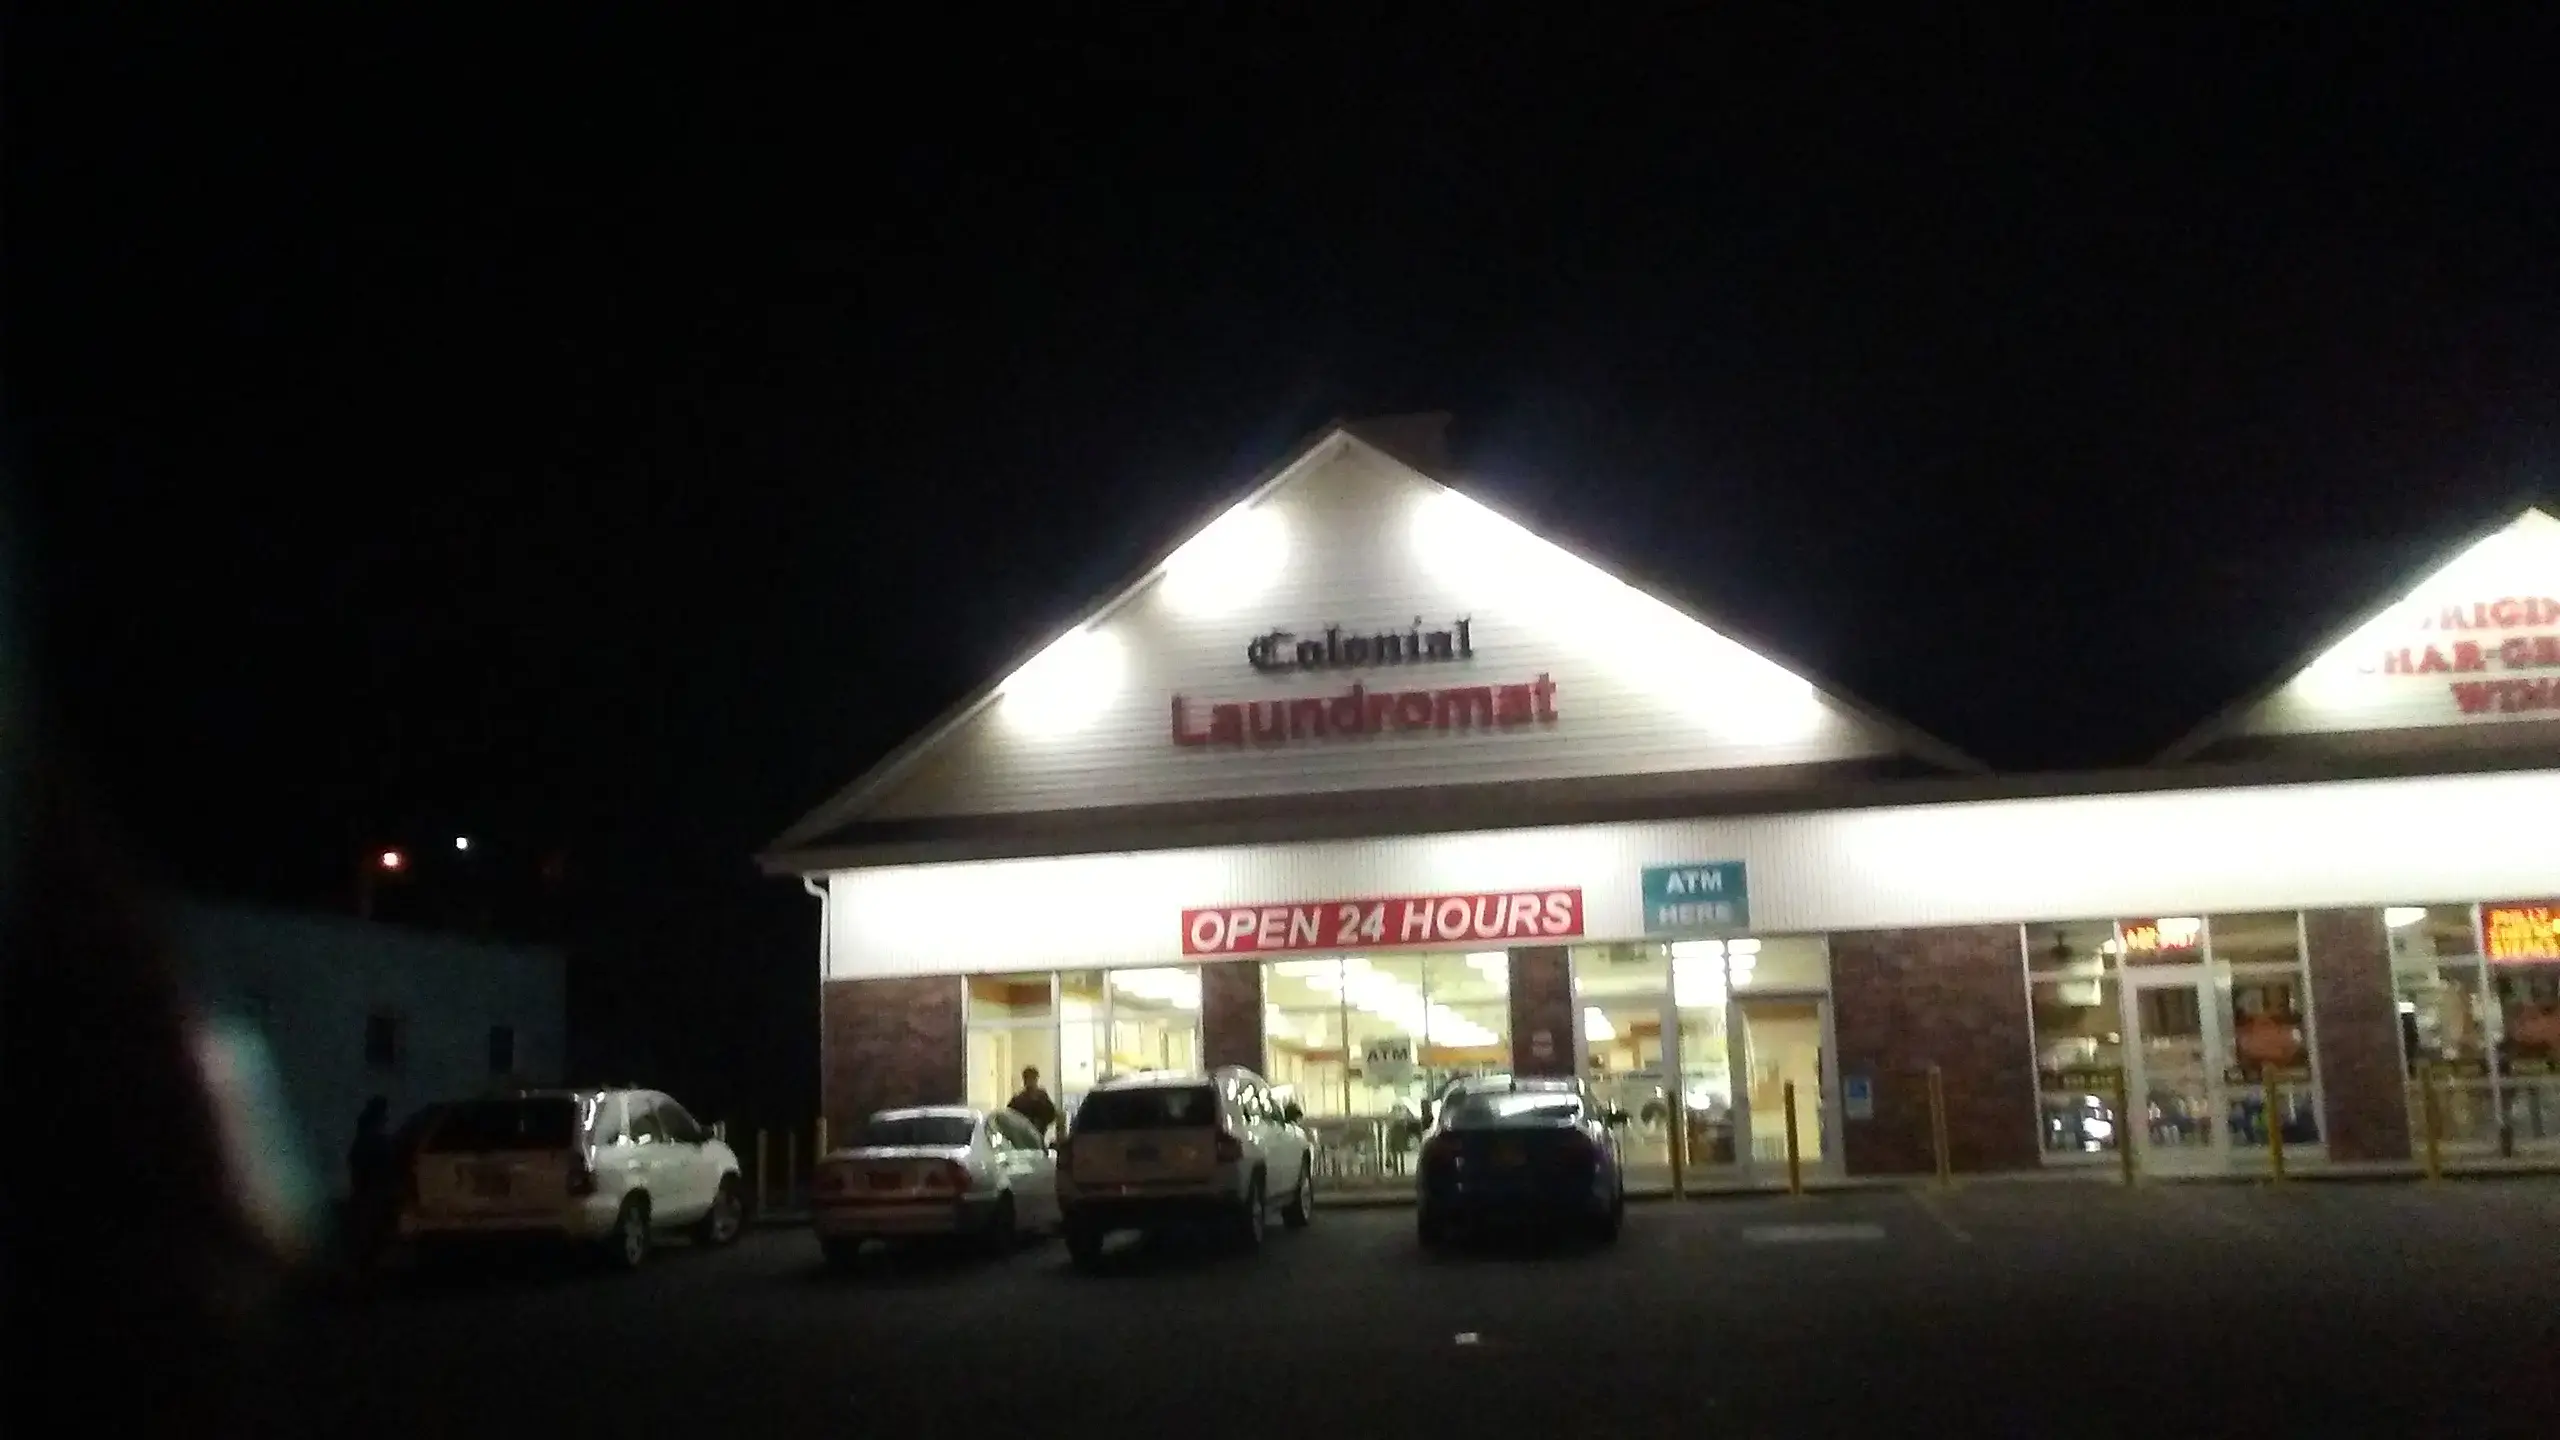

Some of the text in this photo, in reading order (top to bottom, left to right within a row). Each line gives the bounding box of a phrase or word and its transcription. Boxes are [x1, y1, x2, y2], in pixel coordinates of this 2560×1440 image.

[1247, 613, 1473, 673] Colonial
[1172, 673, 1558, 748] Laundromat
[1665, 868, 1722, 895] ATM
[1190, 890, 1573, 953] OPEN 24 HOURS
[1658, 901, 1732, 926] HERE
[1366, 1046, 1408, 1062] ATM
